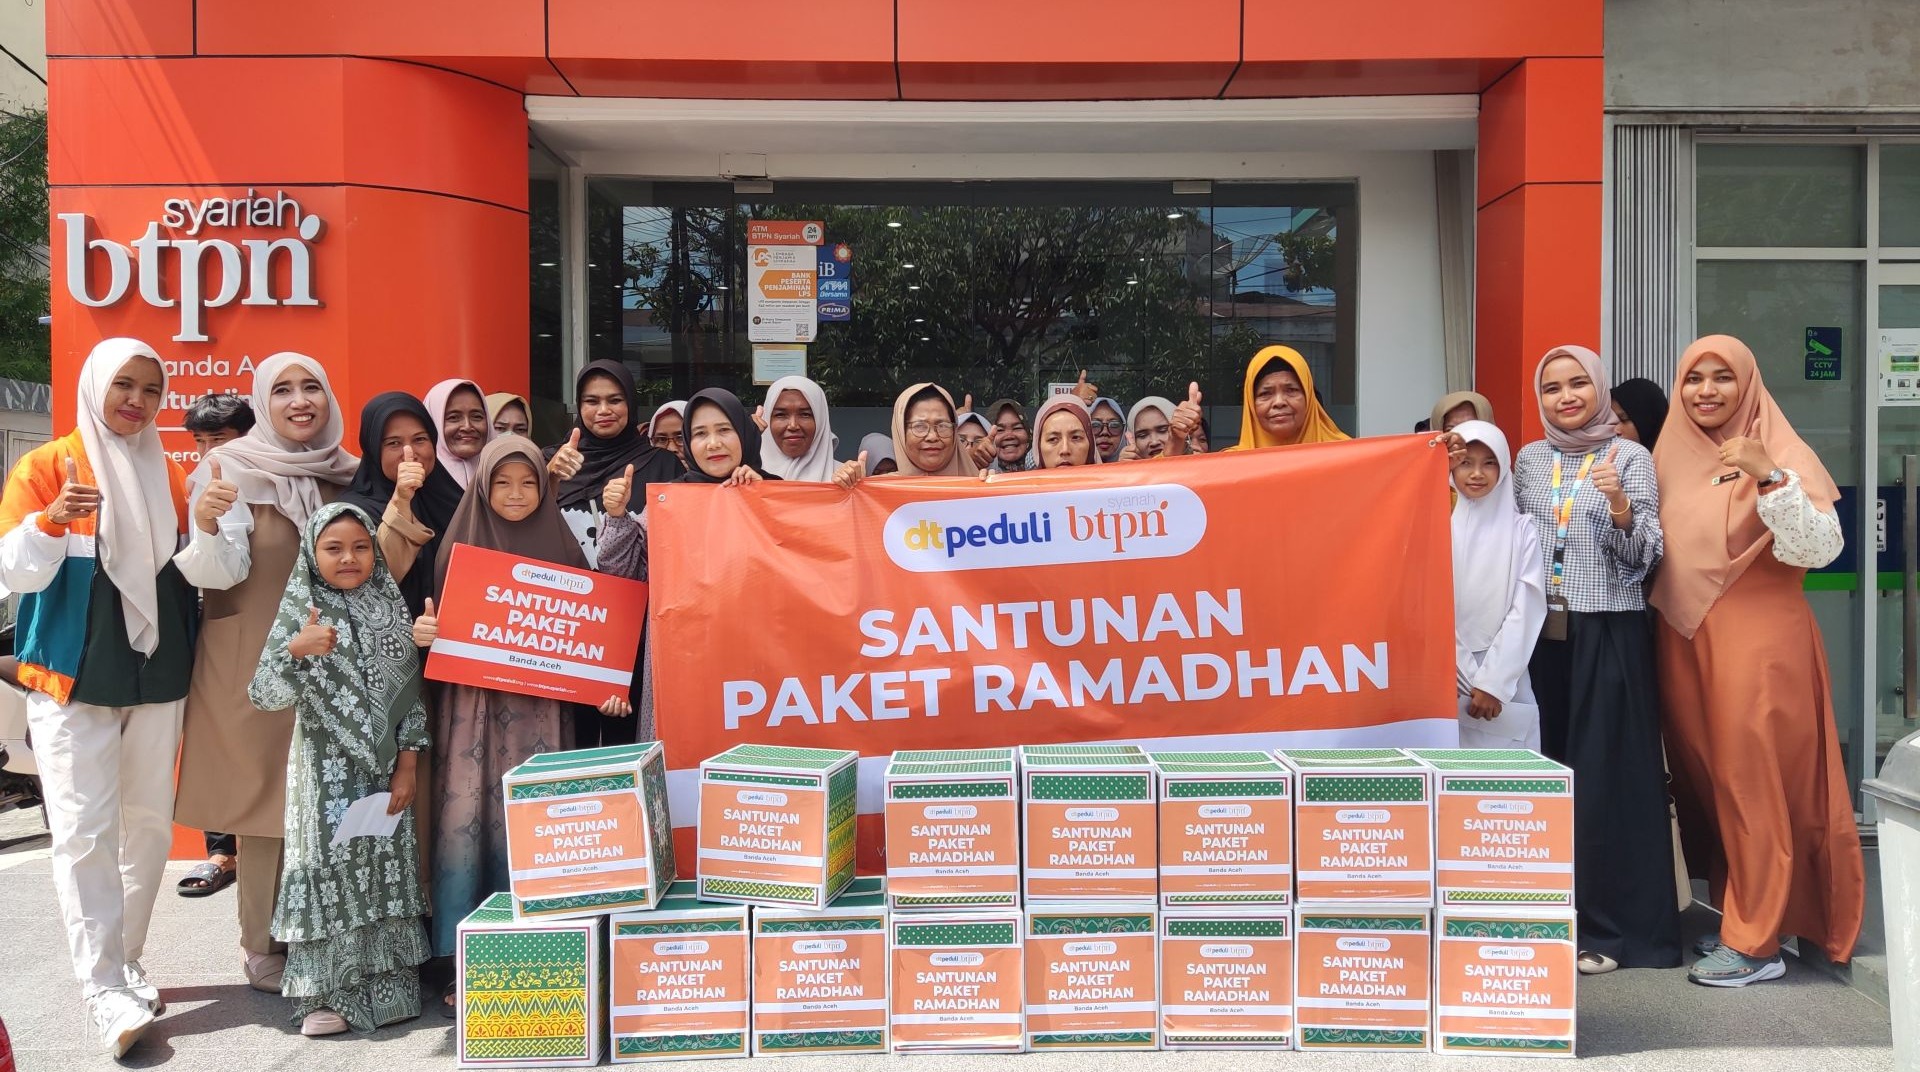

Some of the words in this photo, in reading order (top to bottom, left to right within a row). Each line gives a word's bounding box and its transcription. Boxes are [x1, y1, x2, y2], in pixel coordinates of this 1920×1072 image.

[162, 188, 300, 235] syariah
[819, 262, 835, 276] iB
[57, 212, 320, 342] btpn
[164, 355, 230, 376] anda
[903, 511, 1052, 558] dtpeduli
[1065, 500, 1168, 553] btpn
[485, 585, 608, 624] SANTUNAN
[507, 609, 581, 637] PAKET
[859, 588, 1244, 658] SANTUNAN
[472, 622, 605, 661] RAMADHAN
[509, 655, 538, 667] Banda
[539, 659, 562, 670] Aceh
[722, 668, 951, 730] PAKET
[973, 642, 1389, 714] RAMADHAN
[724, 809, 799, 825] SANTUNAN
[535, 818, 618, 837] SANTUNAN
[739, 823, 784, 836] PAKET
[911, 824, 990, 837] SANTUNAN
[1185, 823, 1264, 835] SANTUNAN
[1464, 819, 1547, 832] SANTUNAN
[1052, 827, 1132, 839] SANTUNAN
[1323, 829, 1404, 841] SANTUNAN
[1481, 833, 1530, 845] PAKET
[553, 834, 602, 849] PAKET
[720, 835, 801, 852] RAMADHAN
[928, 838, 975, 849] PAKET
[1069, 841, 1116, 852] PAKET
[1202, 837, 1248, 848] PAKET
[535, 845, 623, 865] RAMADHAN
[1341, 843, 1388, 854] PAKET
[1461, 846, 1549, 859] RAMADHAN
[910, 851, 995, 863] RAMADHAN
[1050, 854, 1135, 865] RAMADHAN
[1183, 850, 1267, 862] RAMADHAN
[1321, 856, 1407, 867] RAMADHAN
[640, 960, 722, 974] SANTUNAN
[779, 958, 860, 972] SANTUNAN
[1051, 960, 1130, 973] SANTUNAN
[1187, 963, 1266, 975] SANTUNAN
[1323, 956, 1403, 969] SANTUNAN
[917, 972, 996, 984] SANTUNAN
[1340, 970, 1387, 982] PAKET
[1465, 965, 1548, 978] SANTUNAN
[658, 974, 706, 986] PAKET
[796, 972, 843, 985] PAKET
[1068, 974, 1114, 986] PAKET
[1204, 977, 1250, 988] PAKET
[1483, 979, 1531, 991] PAKET
[637, 987, 725, 1001] RAMADHAN
[777, 985, 863, 999] RAMADHAN
[934, 985, 980, 997] PAKET
[1049, 987, 1134, 1001] RAMADHAN
[1184, 990, 1269, 1001] RAMADHAN
[1320, 983, 1406, 996] RAMADHAN
[914, 998, 1000, 1011] RAMADHAN
[1462, 992, 1551, 1005] RAMADHAN
